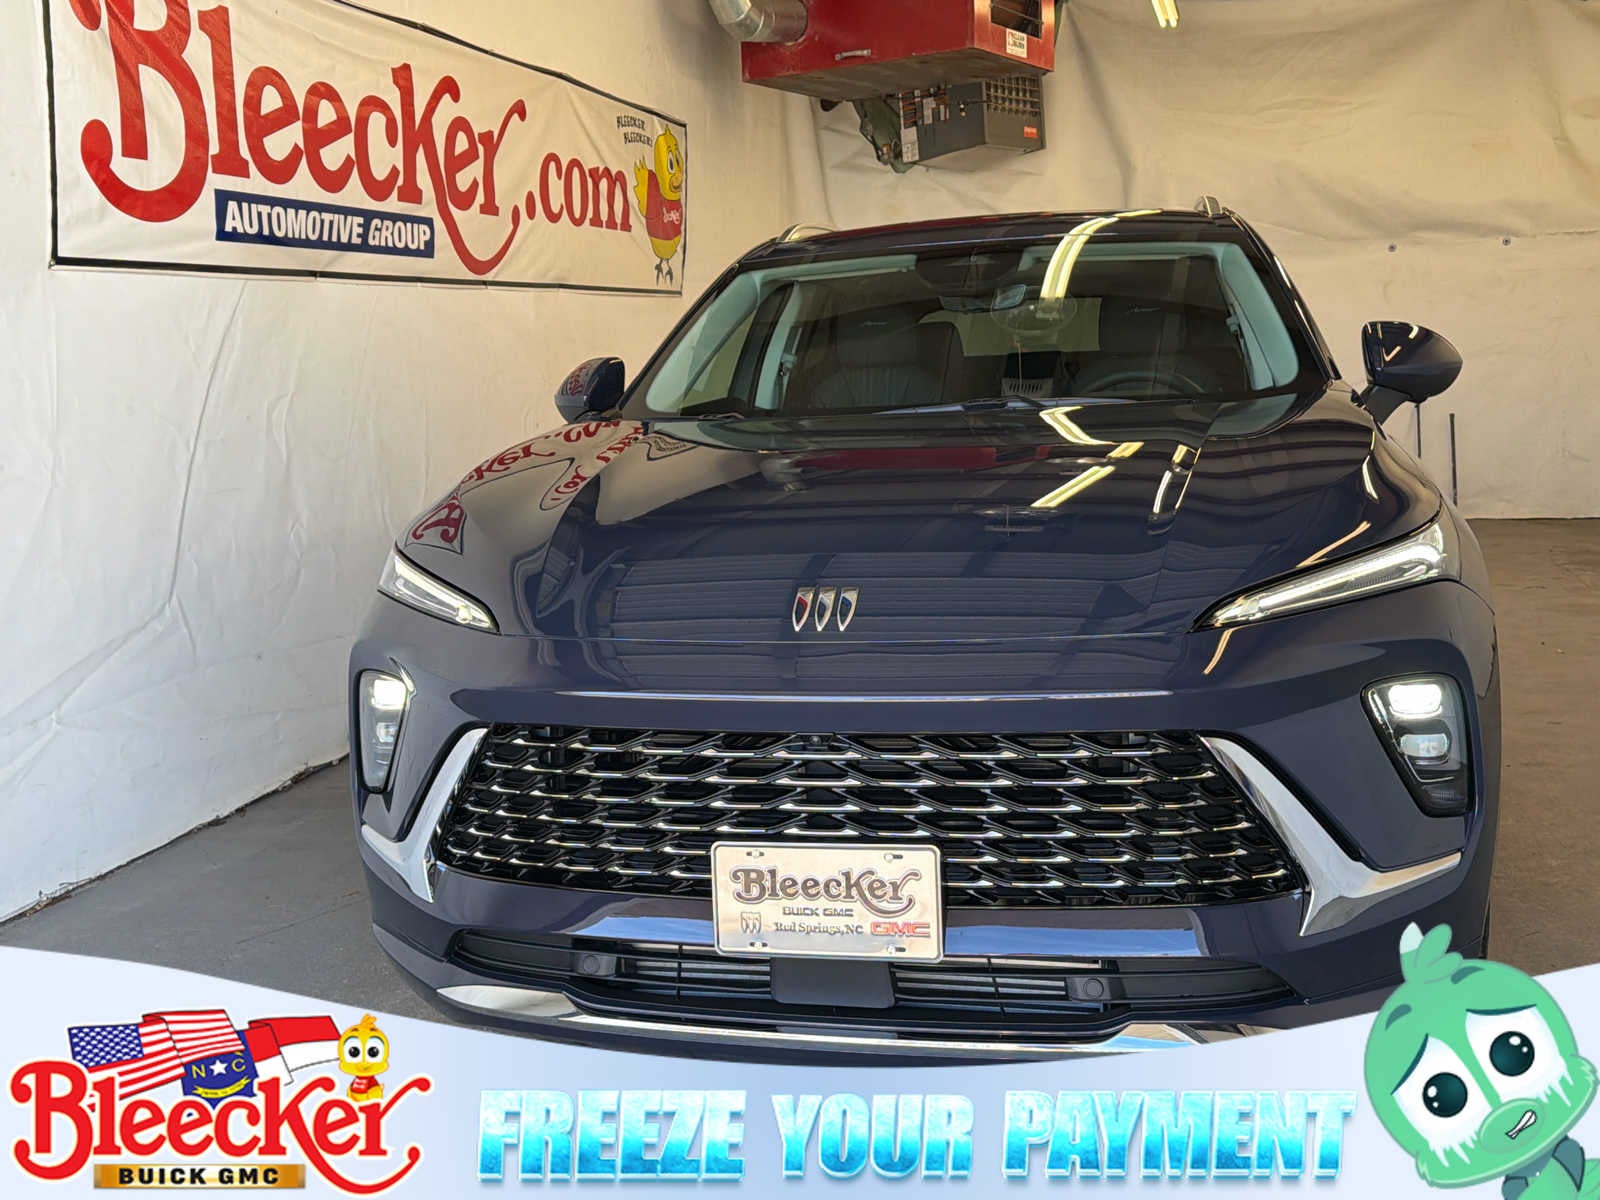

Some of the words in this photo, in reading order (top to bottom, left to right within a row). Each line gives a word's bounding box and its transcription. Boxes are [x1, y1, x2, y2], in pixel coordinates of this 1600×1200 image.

[224, 200, 364, 245] AUTOMOTIVE
[368, 218, 431, 250] GROUP
[783, 906, 820, 916] BUICK
[823, 908, 854, 917] GMC
[774, 922, 797, 932] Red
[870, 921, 931, 938] GMC
